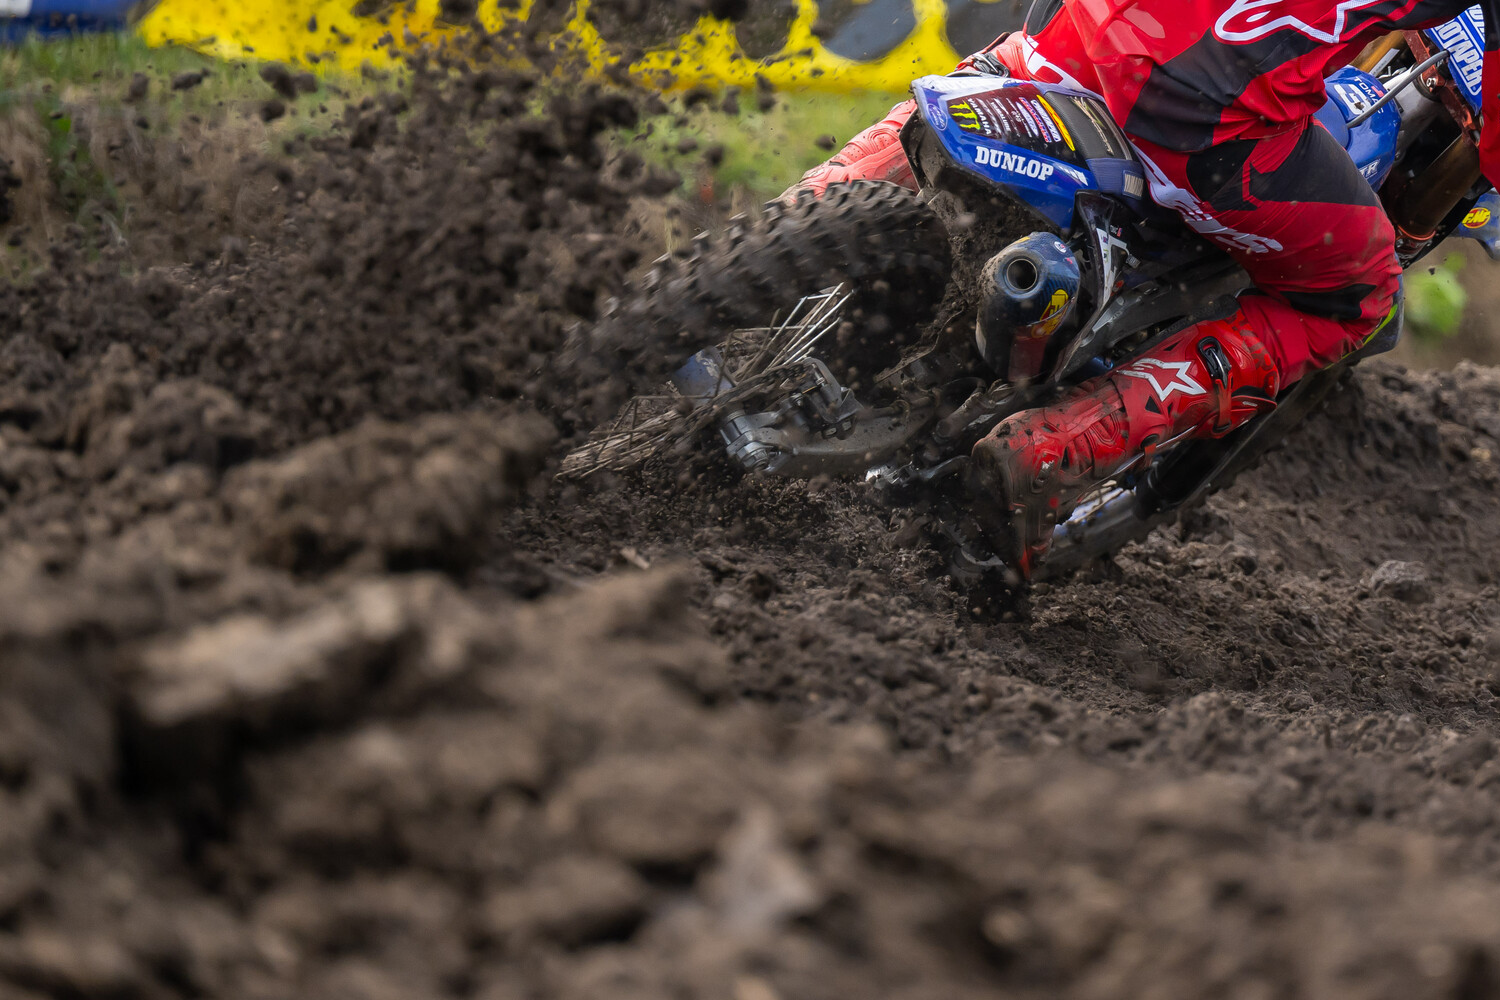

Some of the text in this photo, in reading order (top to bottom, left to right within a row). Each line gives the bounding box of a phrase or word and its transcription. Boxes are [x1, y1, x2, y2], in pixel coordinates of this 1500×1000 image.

[967, 97, 992, 135] YAMAHA
[974, 145, 1053, 181] DUNLOP
[1462, 209, 1491, 224] FMF
